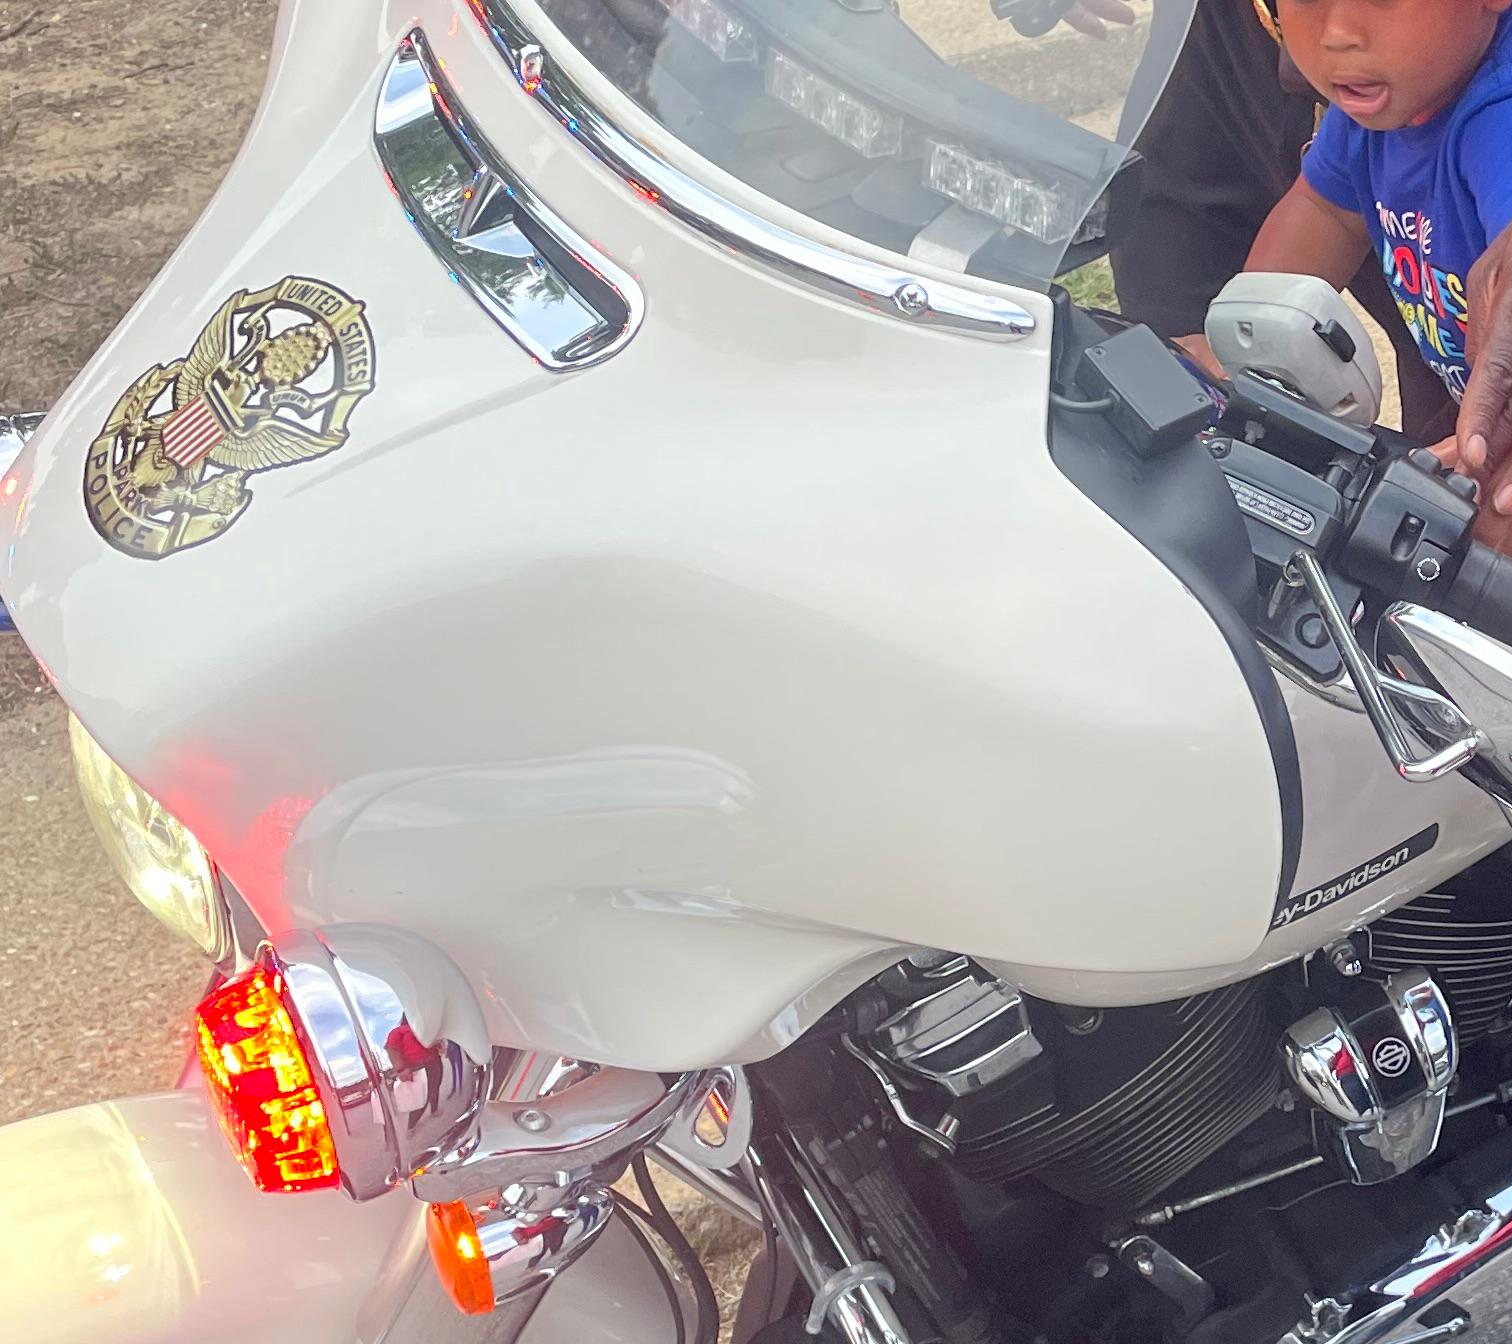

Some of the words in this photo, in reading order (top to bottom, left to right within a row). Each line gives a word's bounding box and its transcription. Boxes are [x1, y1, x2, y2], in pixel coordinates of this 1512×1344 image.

[287, 282, 344, 318] UNITED
[339, 321, 369, 384] STATES
[89, 449, 153, 549] POLICE
[113, 463, 151, 520] PARK
